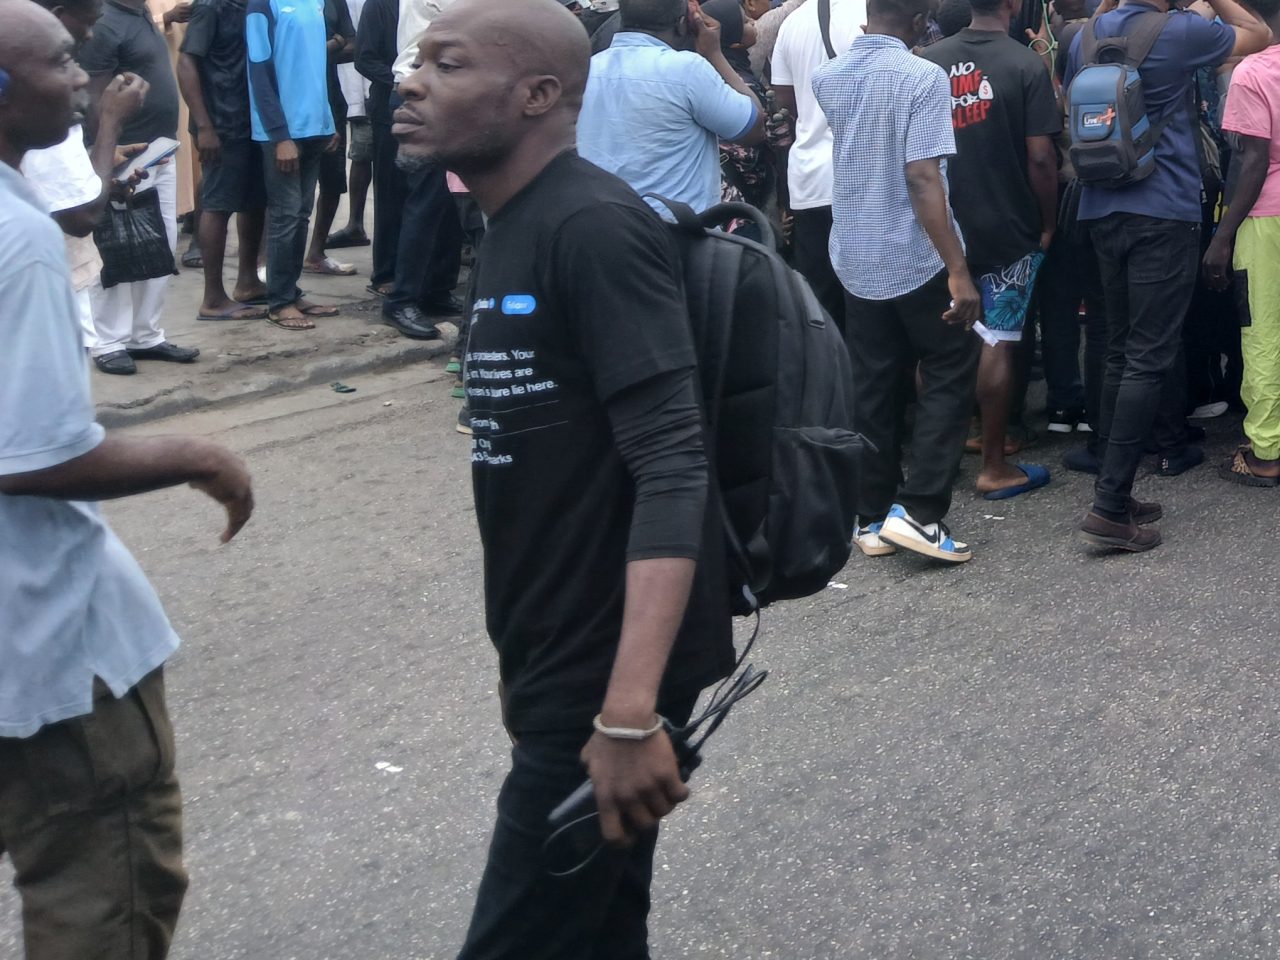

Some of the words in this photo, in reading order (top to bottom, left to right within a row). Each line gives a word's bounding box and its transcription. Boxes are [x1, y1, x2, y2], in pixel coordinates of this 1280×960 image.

[950, 62, 975, 77] NO
[952, 70, 982, 96] IME
[514, 368, 533, 377] are
[526, 381, 558, 392] here.
